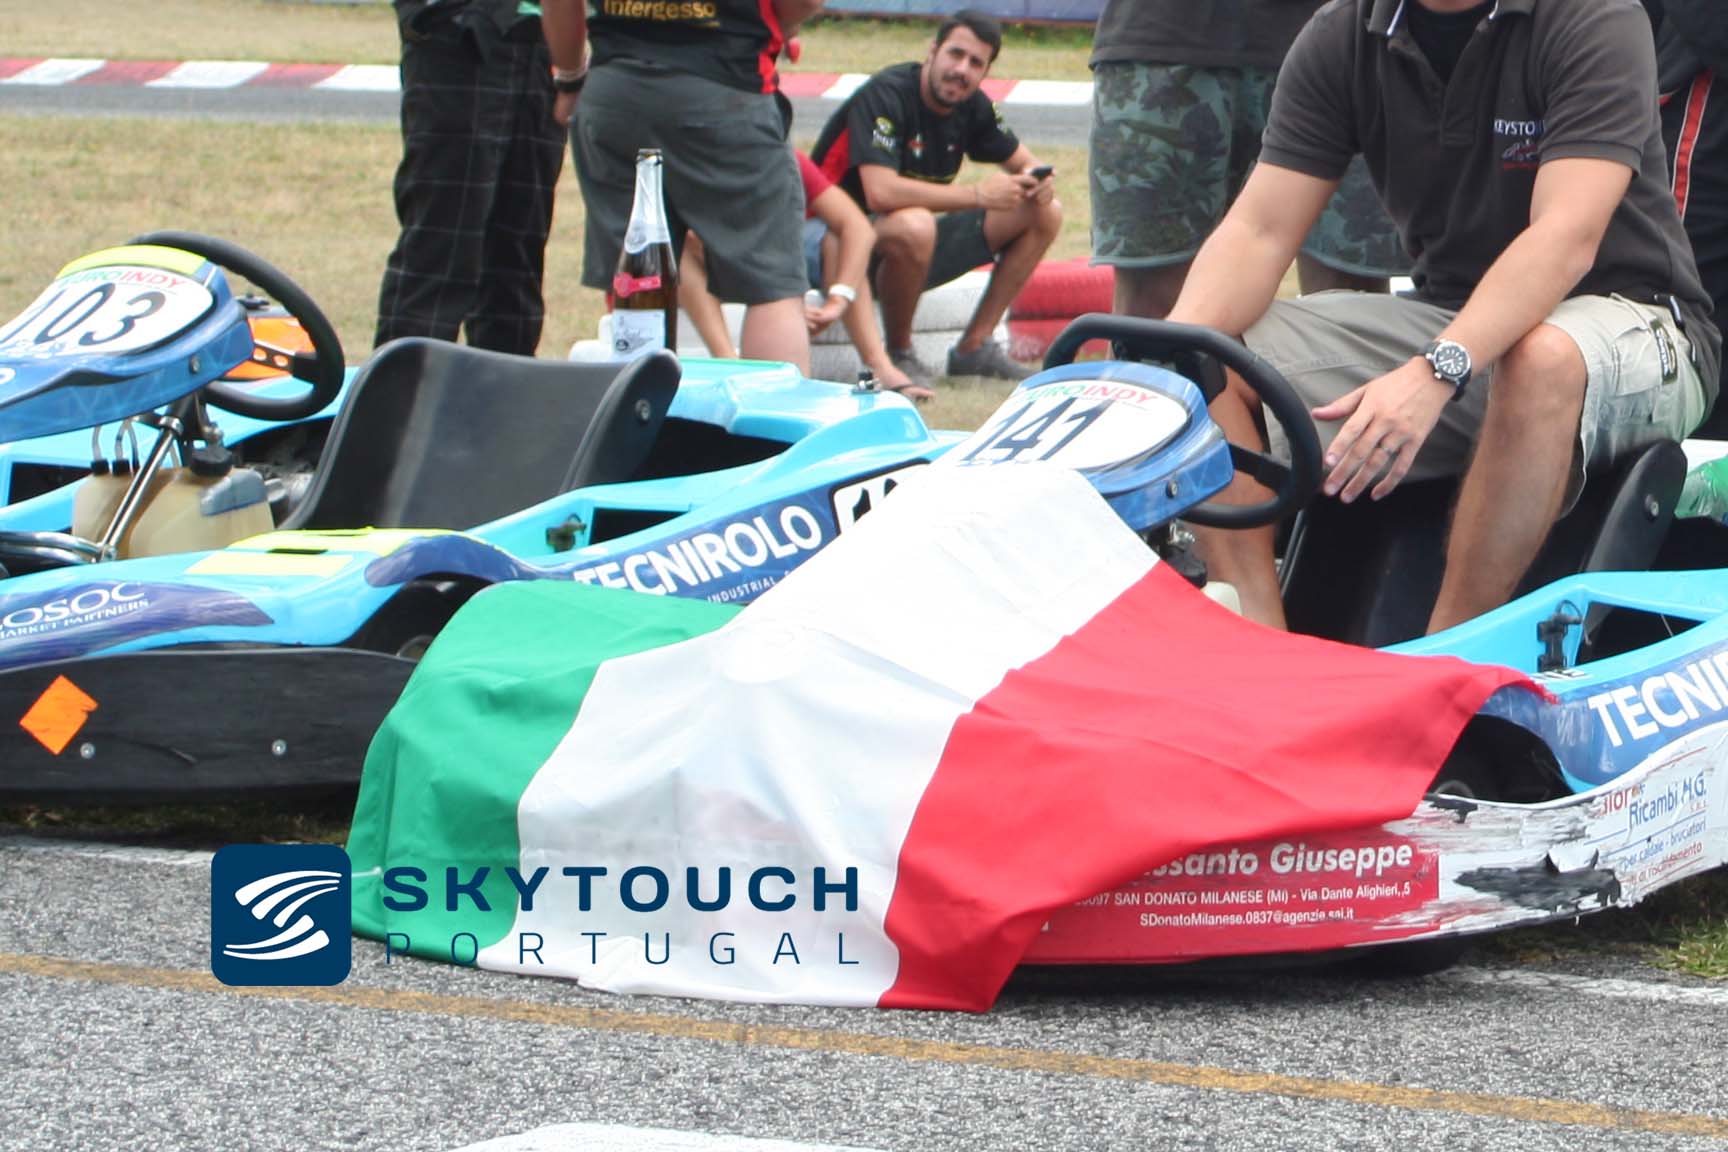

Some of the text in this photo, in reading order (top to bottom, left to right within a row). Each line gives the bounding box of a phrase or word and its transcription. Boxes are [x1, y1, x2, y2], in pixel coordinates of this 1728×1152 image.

[0, 282, 166, 346] 103
[962, 397, 1117, 464] 141
[0, 582, 145, 629] OSOC
[1143, 842, 1413, 877] santo Giuseppe
[1114, 892, 1140, 906] SAN
[1144, 891, 1197, 906] DONATO
[1200, 886, 1264, 905] MILANESE
[1300, 886, 1318, 902] Via
[1321, 884, 1354, 901] Dante
